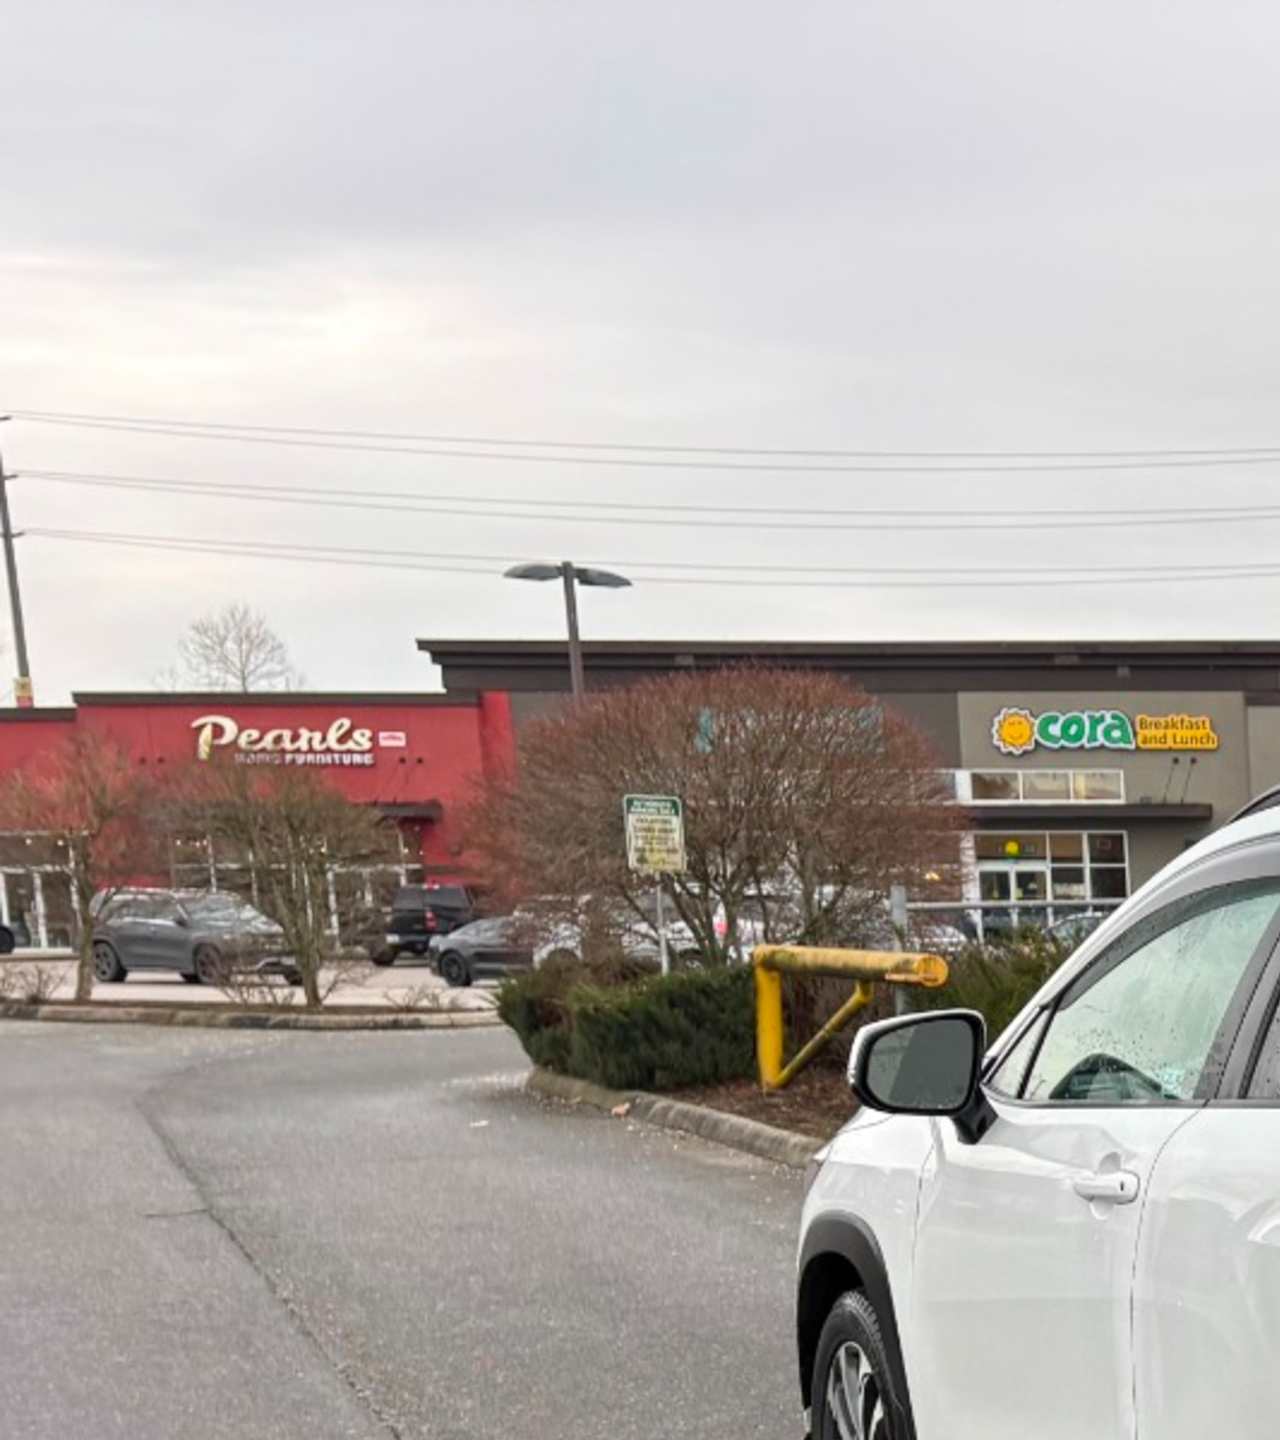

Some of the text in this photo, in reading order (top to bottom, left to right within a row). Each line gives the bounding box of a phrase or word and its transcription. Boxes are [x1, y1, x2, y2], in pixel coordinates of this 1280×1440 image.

[1036, 710, 1134, 747] cora
[1139, 716, 1209, 731] Breakfast
[191, 714, 374, 761] Pearls
[1141, 729, 1215, 746] and Lunch
[285, 752, 374, 765] FURNITURE
